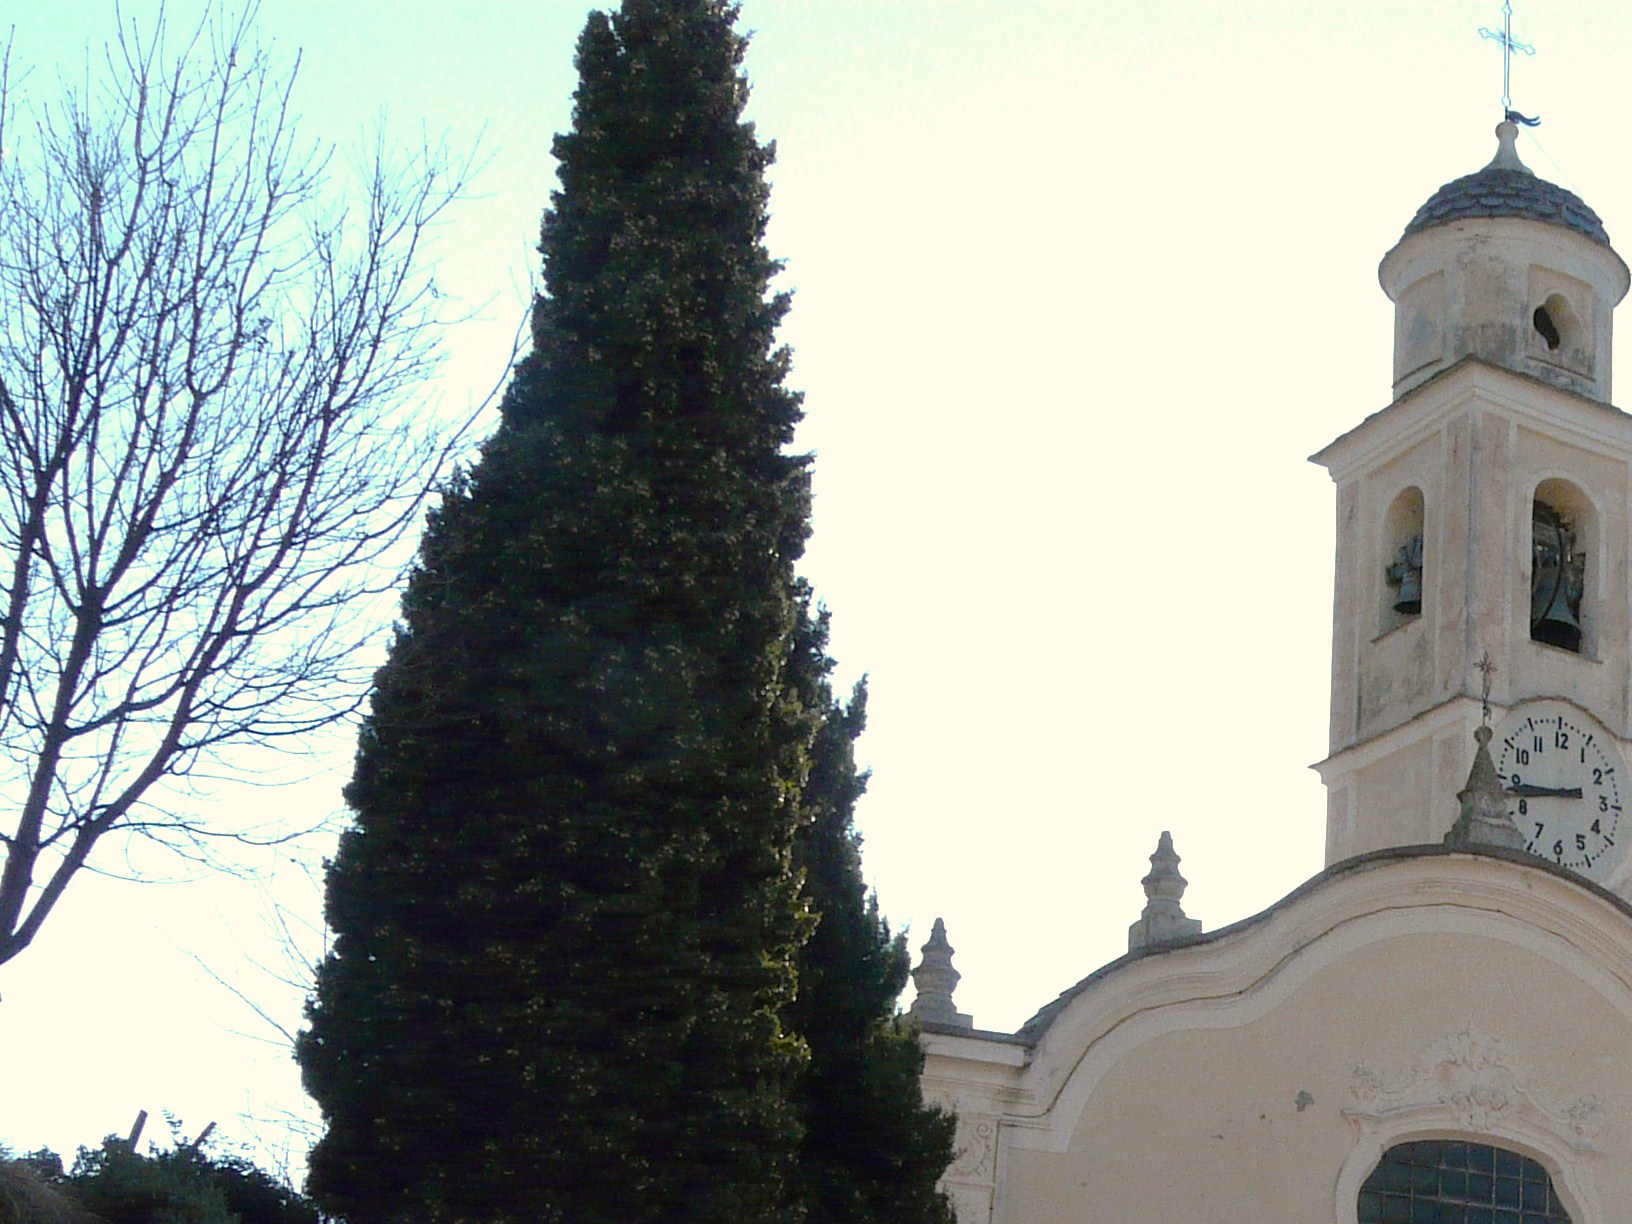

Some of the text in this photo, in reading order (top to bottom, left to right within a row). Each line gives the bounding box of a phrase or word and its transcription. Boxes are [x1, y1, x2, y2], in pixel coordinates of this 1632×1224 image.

[1533, 735, 1543, 753] 11
[1554, 731, 1569, 750] 12
[1515, 747, 1530, 766] 10
[1580, 747, 1585, 763] 1
[1592, 767, 1603, 786] 2
[1518, 799, 1528, 815] 8
[1598, 795, 1609, 813] 3
[1534, 822, 1545, 839] 7
[1590, 818, 1601, 835] 4
[1553, 839, 1563, 856] 6
[1575, 833, 1587, 851] 5
